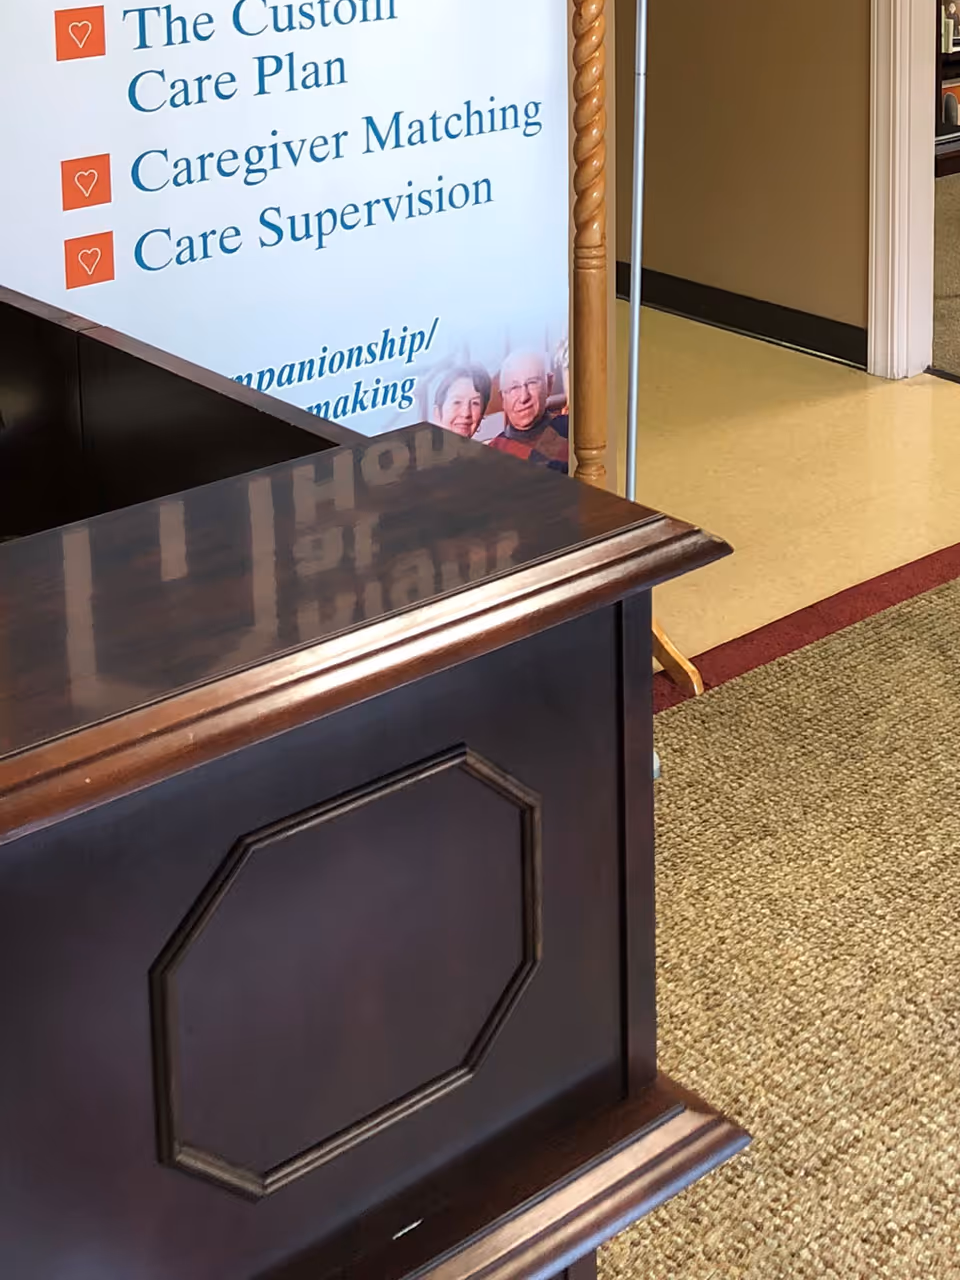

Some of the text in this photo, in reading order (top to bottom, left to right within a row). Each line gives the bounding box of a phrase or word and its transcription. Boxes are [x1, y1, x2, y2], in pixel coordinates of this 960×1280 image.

[122, 4, 216, 50] The
[127, 52, 348, 113] Care Plan
[130, 96, 543, 193] Caregiver Matching
[133, 177, 494, 272] Care Supervision
[230, 317, 440, 392] mpanionship/
[307, 377, 416, 420] making
